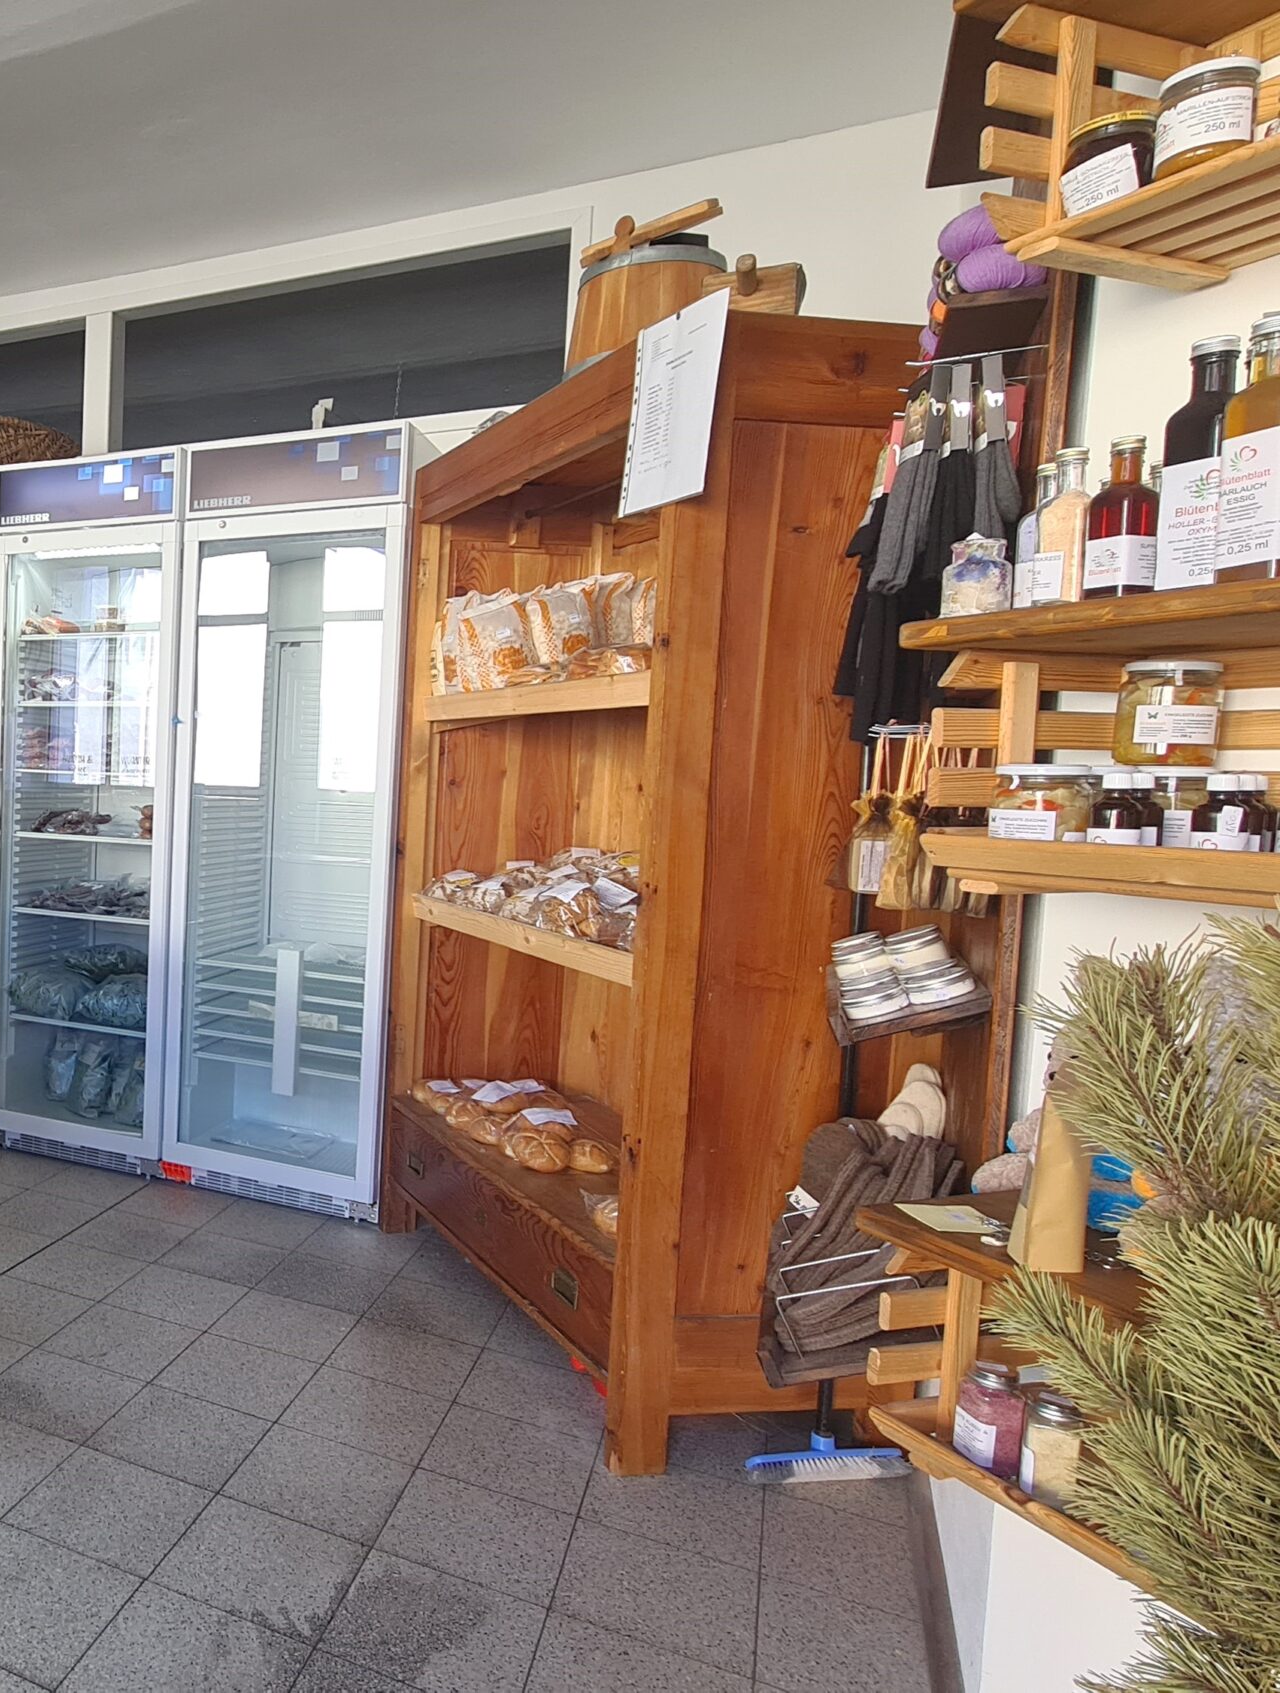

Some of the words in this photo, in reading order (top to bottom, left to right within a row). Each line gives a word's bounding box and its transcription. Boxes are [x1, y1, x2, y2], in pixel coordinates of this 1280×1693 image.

[1203, 119, 1226, 134] 250
[1228, 119, 1242, 130] ml
[1083, 191, 1104, 207] 250
[1106, 184, 1120, 198] ml
[193, 495, 252, 510] LIEBHERR
[1226, 493, 1257, 506] ESSIG
[0, 512, 50, 526] LIEBHERR
[1226, 541, 1253, 557] 0,25
[1254, 538, 1270, 551] ml
